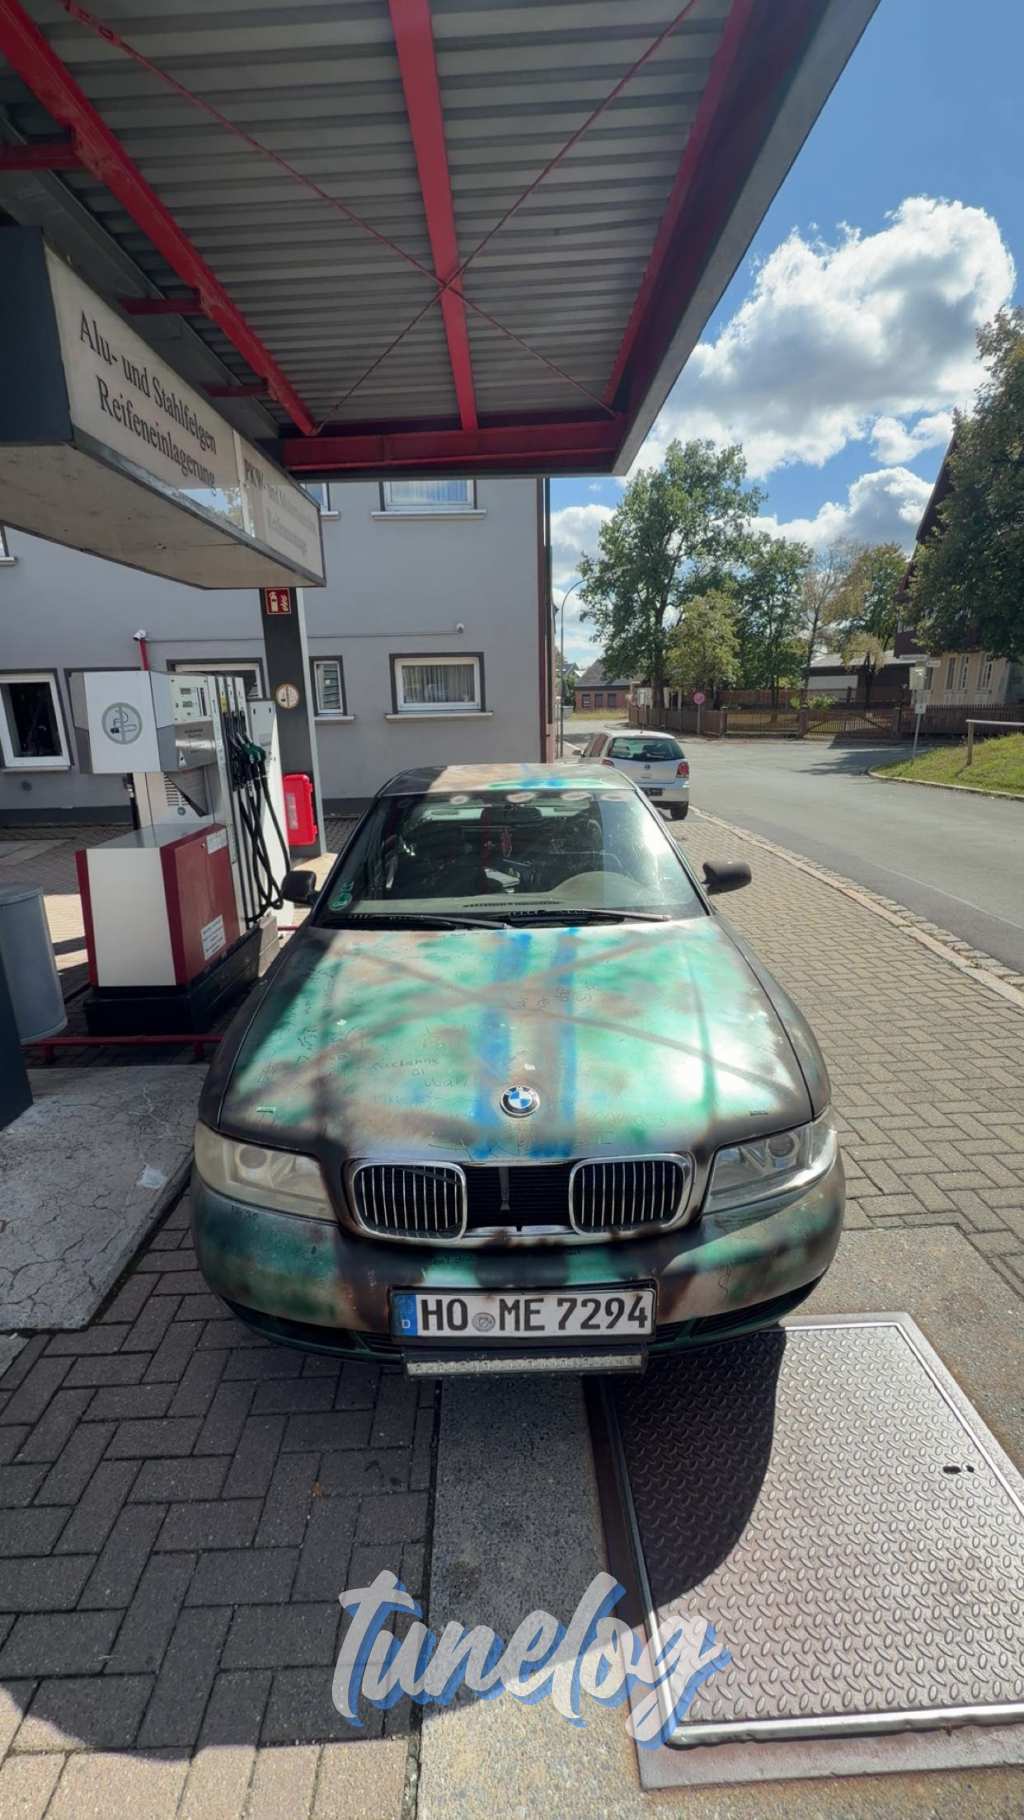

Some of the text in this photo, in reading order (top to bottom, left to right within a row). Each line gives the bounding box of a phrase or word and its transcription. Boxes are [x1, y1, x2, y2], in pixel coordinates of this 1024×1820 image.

[80, 310, 217, 455] Alu- und Stahlfelgen
[96, 374, 217, 497] Reifeneinlagerung
[401, 1295, 648, 1331] D HO ME 7294
